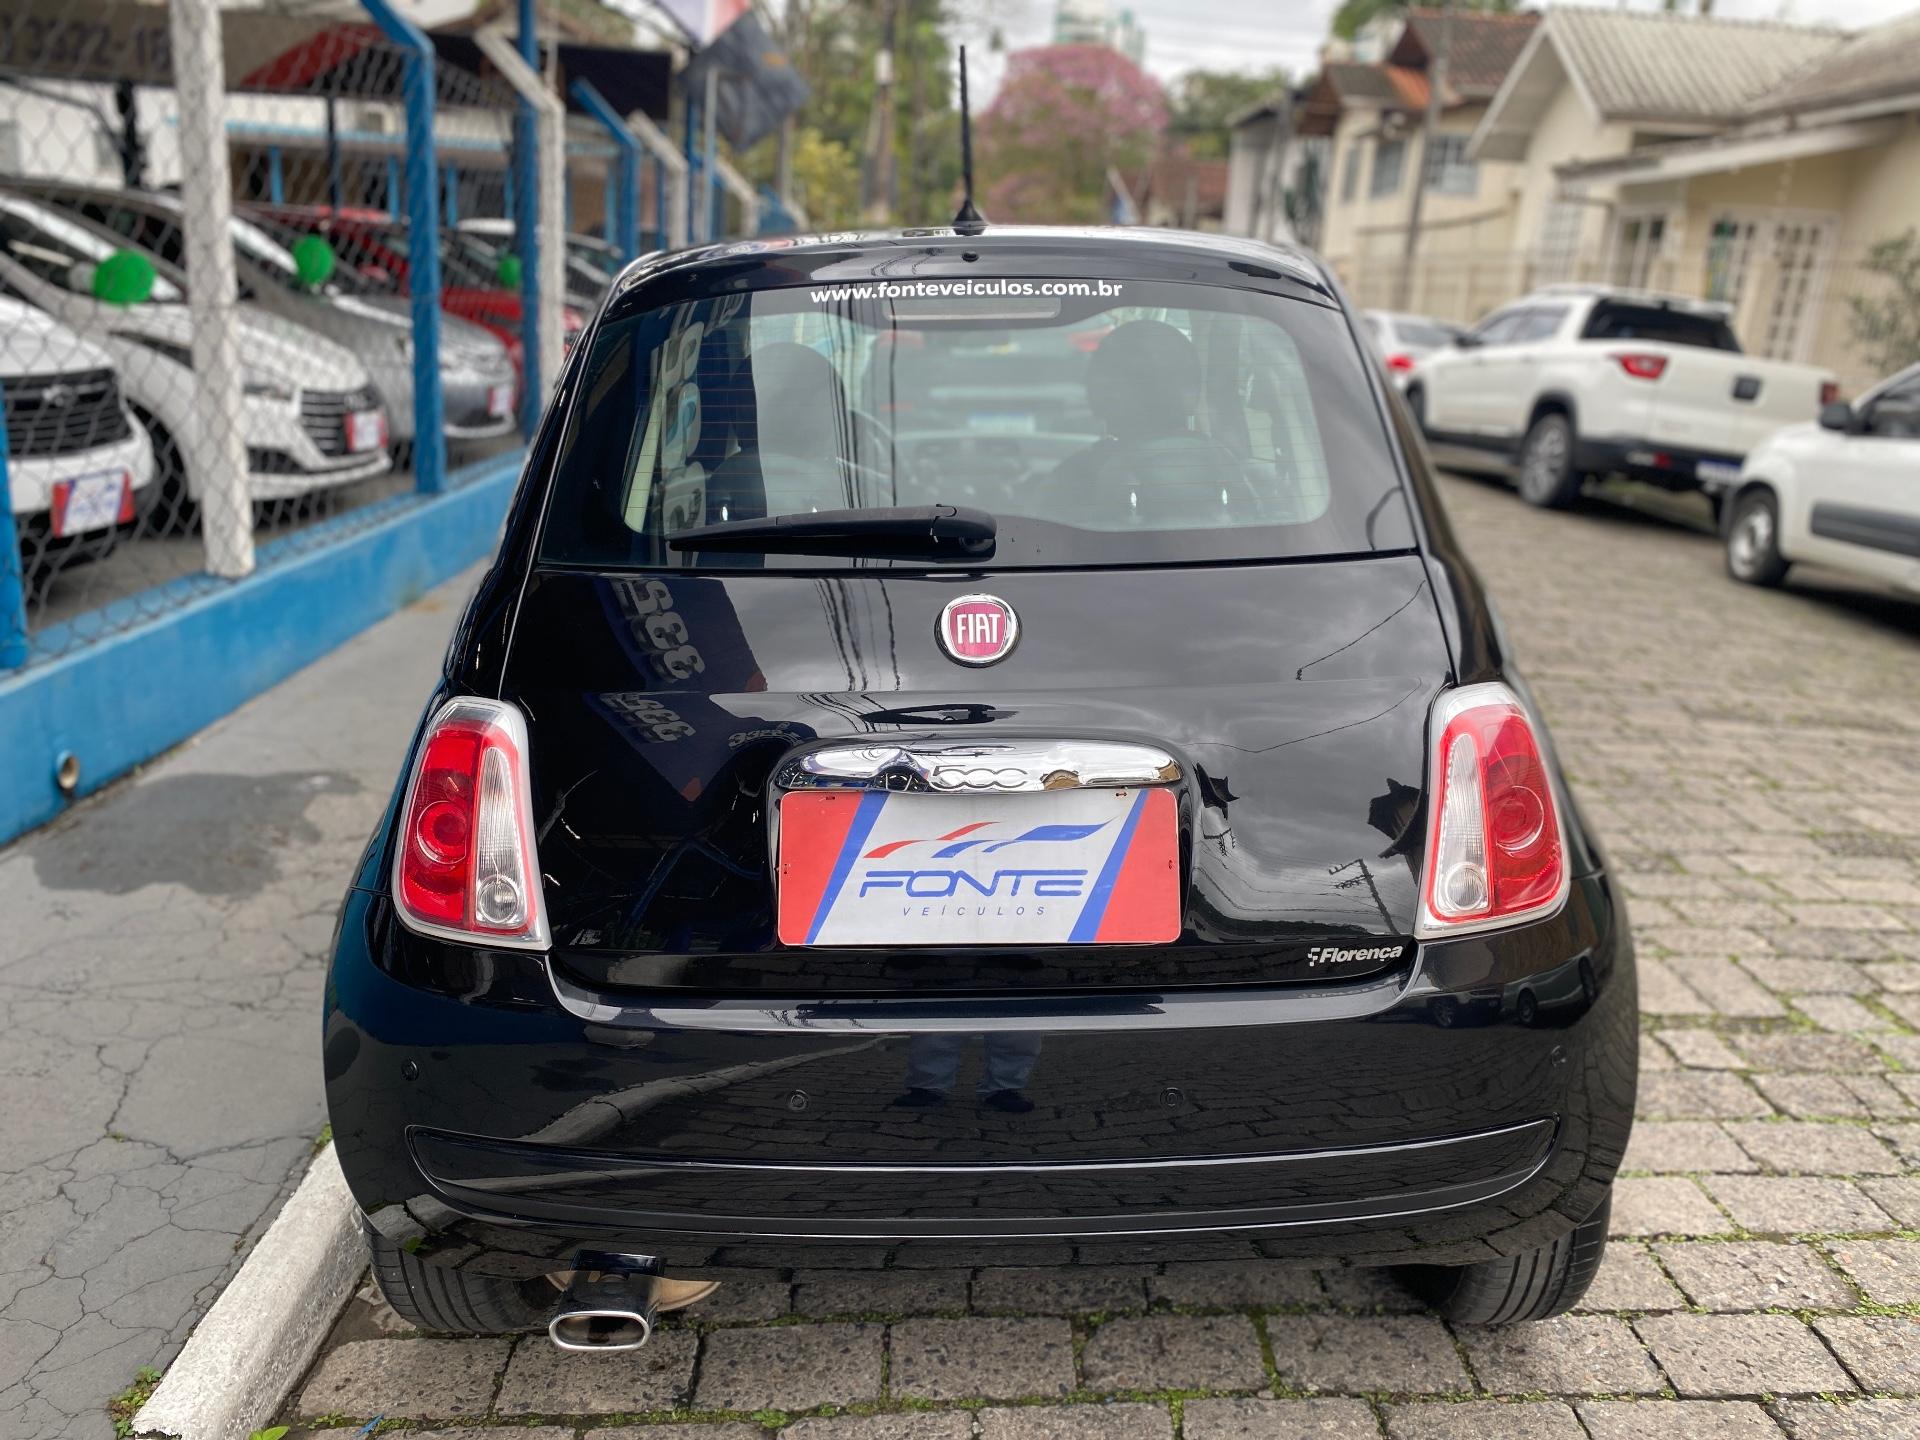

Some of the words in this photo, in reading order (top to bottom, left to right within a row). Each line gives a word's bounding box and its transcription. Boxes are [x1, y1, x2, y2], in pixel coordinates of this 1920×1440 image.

[810, 280, 1123, 303] www.fonteveiculos.com.br
[956, 613, 1001, 645] FIAT
[932, 764, 1029, 791] 500
[859, 869, 1089, 898] FONTE
[902, 905, 1046, 917] VEÍCULOS
[1319, 945, 1404, 963] Florença
